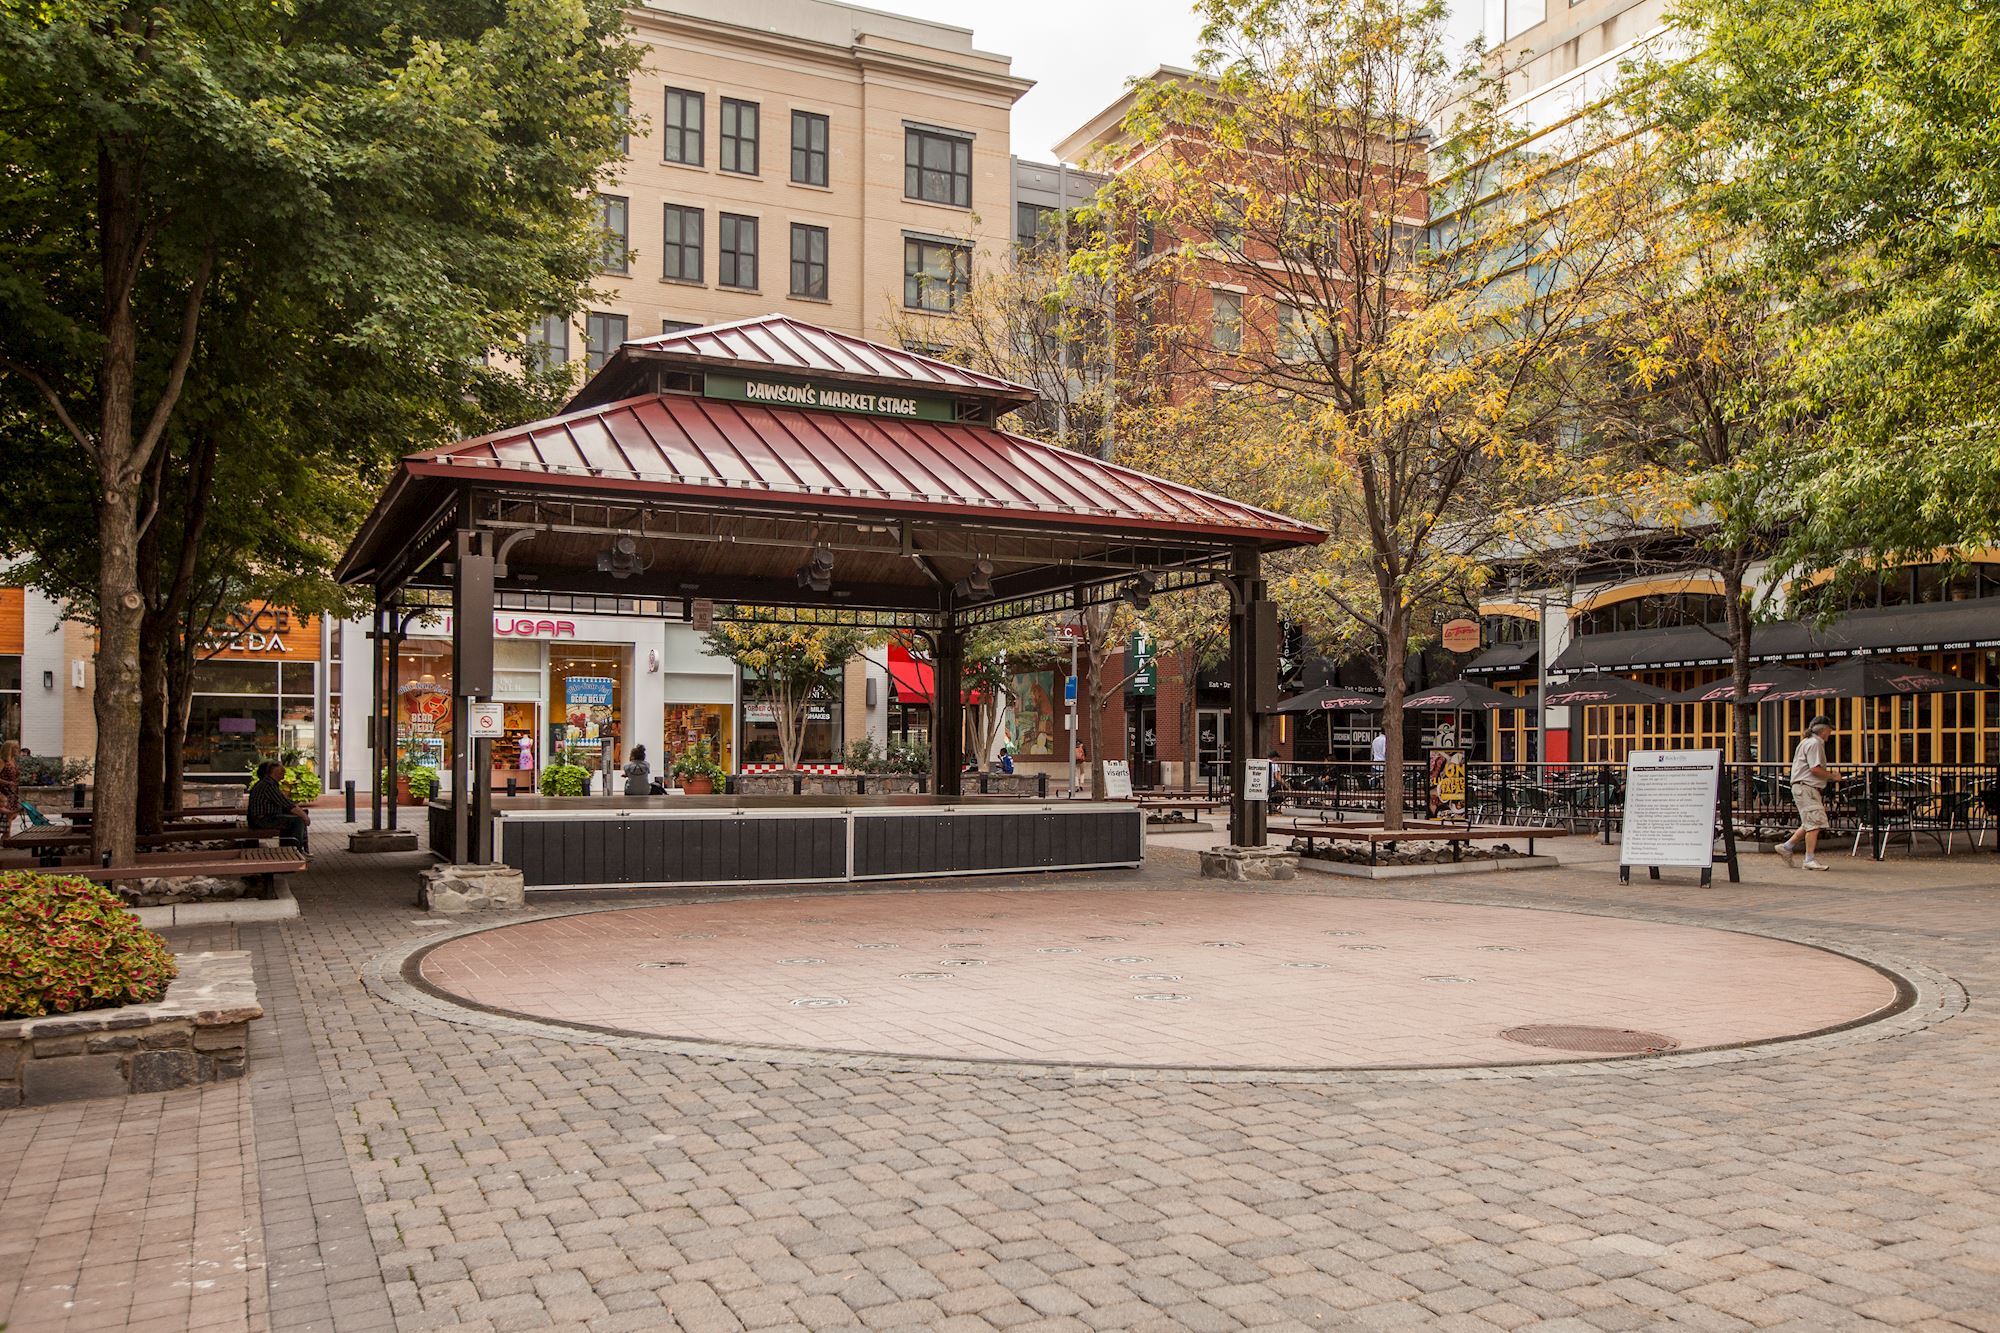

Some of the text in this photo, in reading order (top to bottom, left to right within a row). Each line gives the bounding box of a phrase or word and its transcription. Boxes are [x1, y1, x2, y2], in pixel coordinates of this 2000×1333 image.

[746, 382, 917, 416] DAWSON'S MARKET STAGE
[197, 631, 286, 652] VEDA
[1943, 642, 1971, 650] COCTELES
[1352, 731, 1371, 742] OPEN
